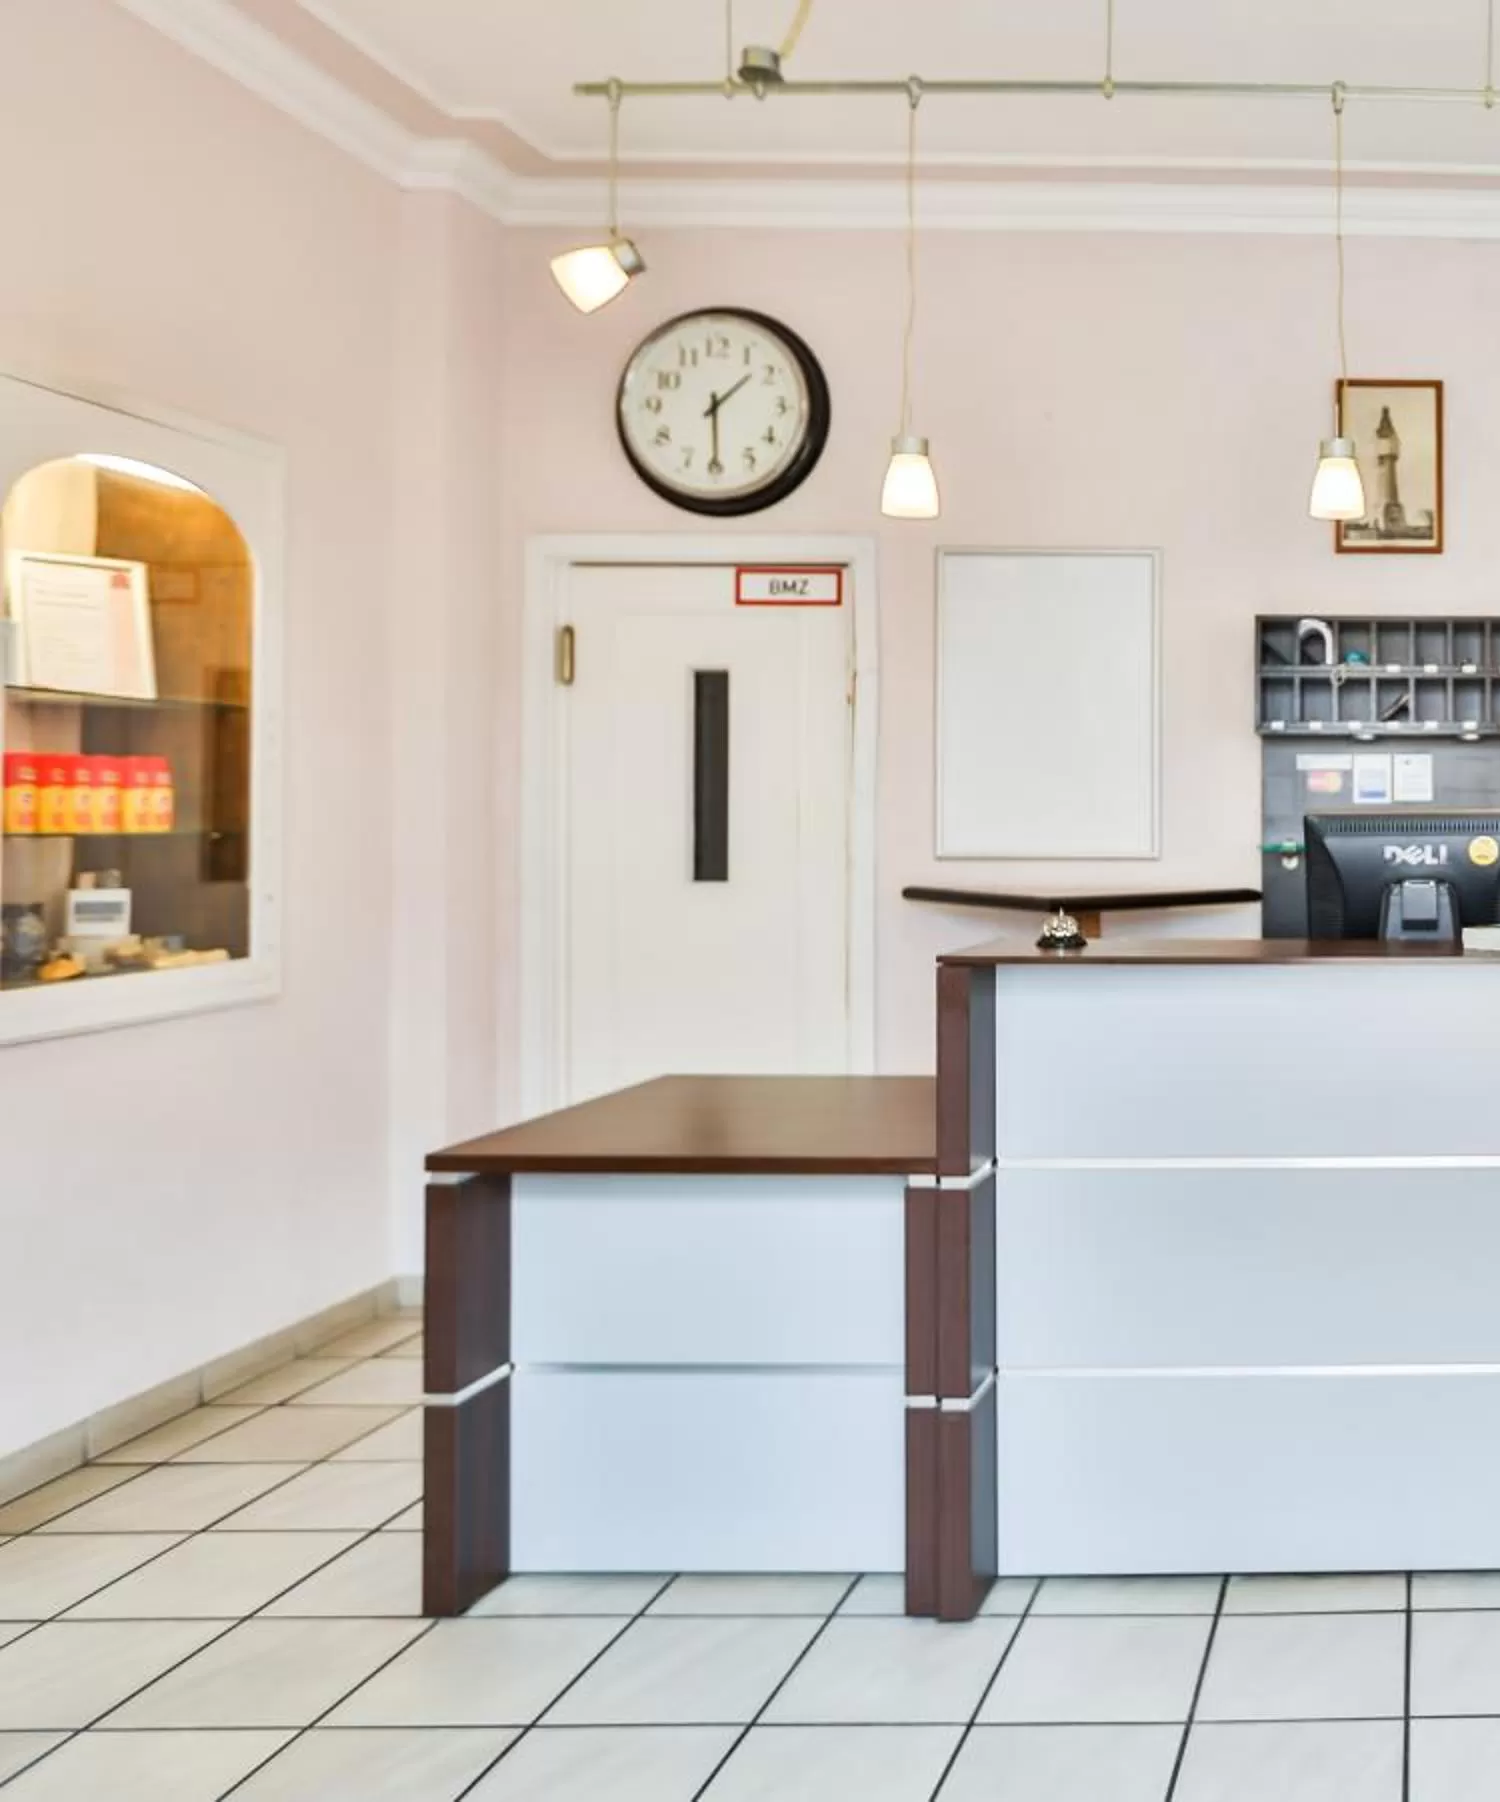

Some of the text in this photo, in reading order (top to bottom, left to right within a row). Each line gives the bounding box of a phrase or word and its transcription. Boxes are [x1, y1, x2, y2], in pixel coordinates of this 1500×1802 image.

[679, 344, 698, 368] 11
[705, 335, 730, 358] 12
[743, 345, 751, 366] 1
[657, 370, 682, 391] 10
[761, 364, 776, 386] 2
[645, 396, 663, 416] 9
[774, 394, 787, 418] 3
[654, 425, 672, 448] 8
[760, 424, 776, 447] 4
[680, 446, 696, 469] 7
[742, 446, 757, 471] 5
[769, 579, 809, 596] BMZ
[1383, 844, 1451, 866] DELL
